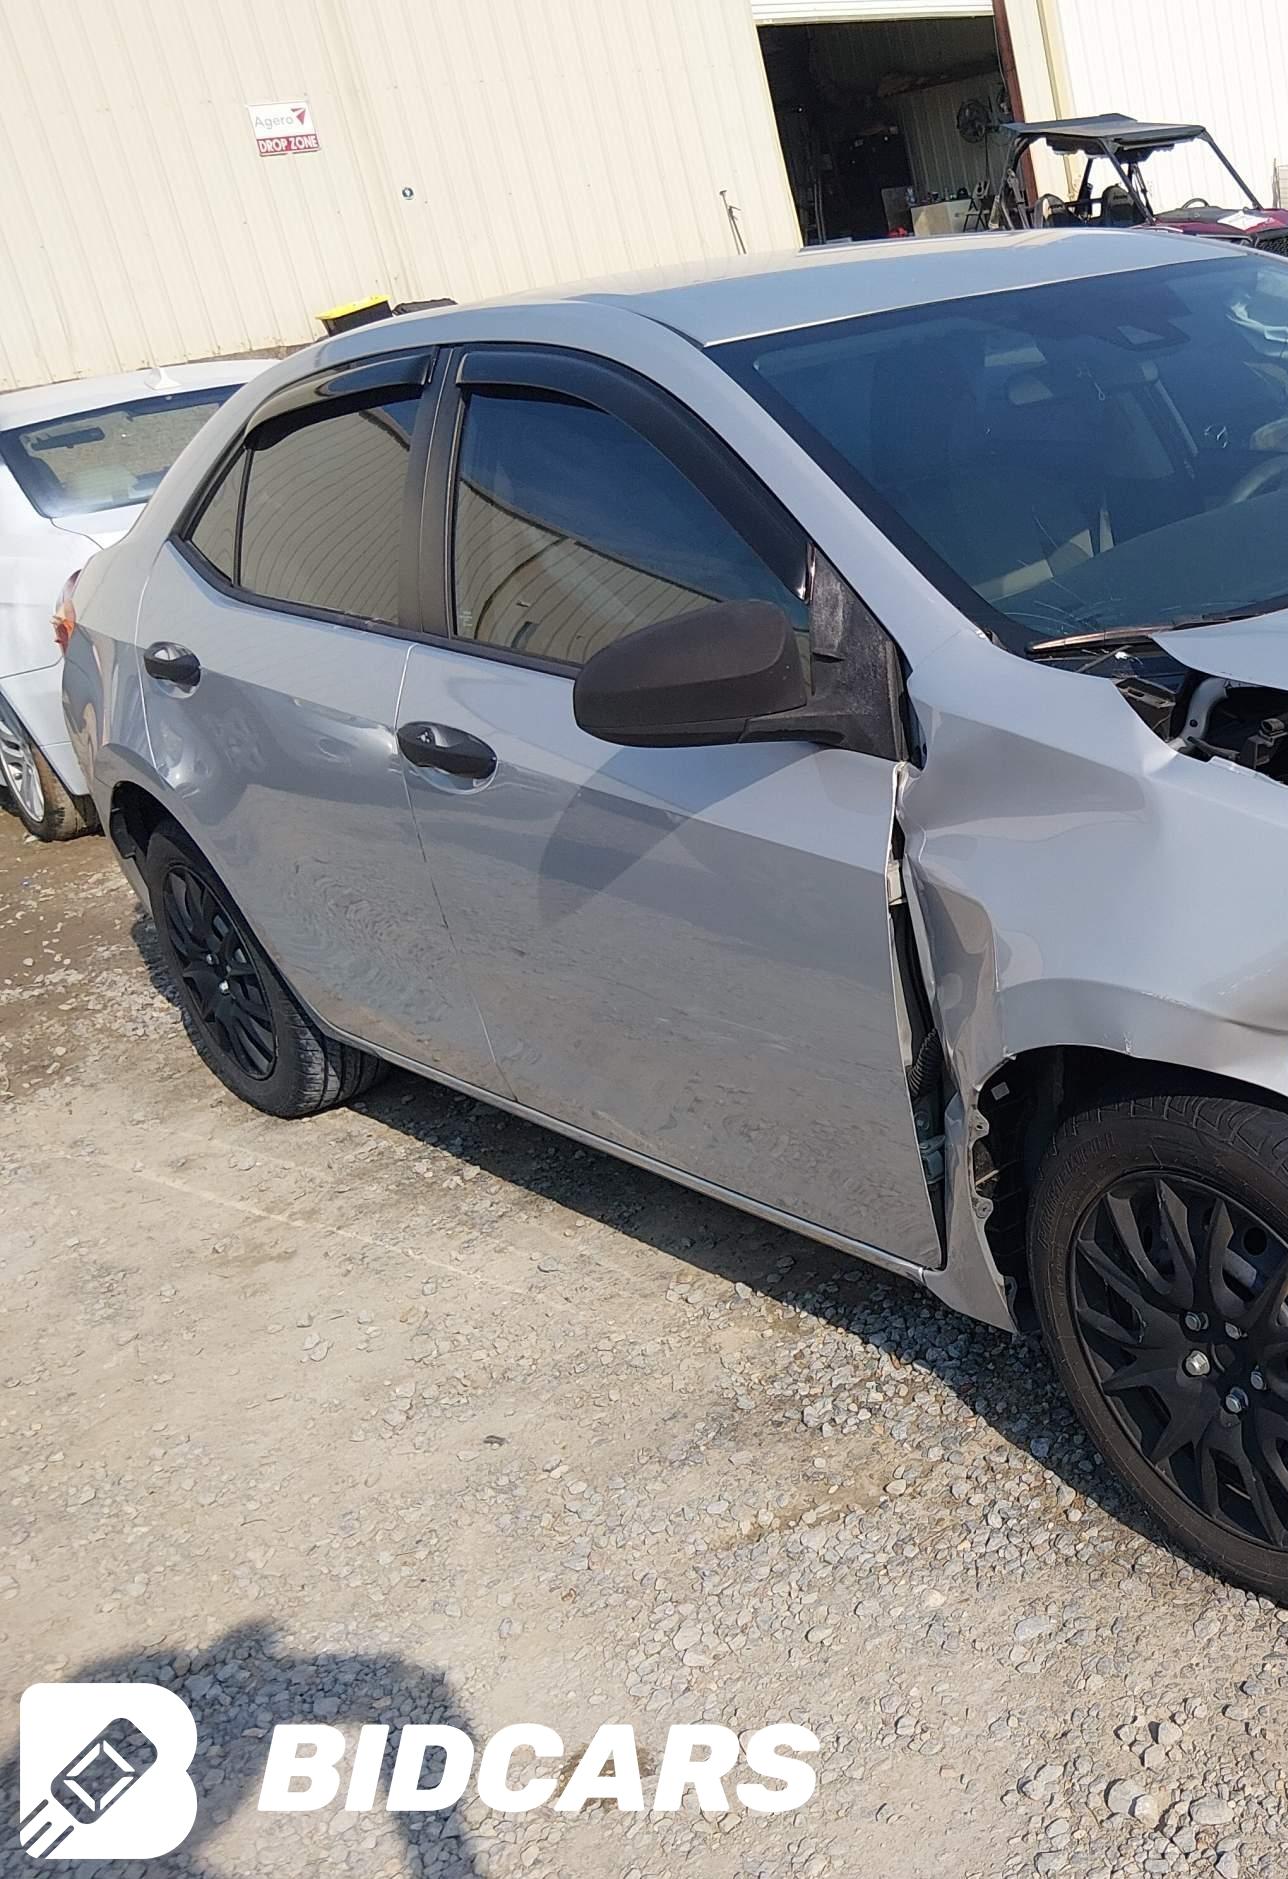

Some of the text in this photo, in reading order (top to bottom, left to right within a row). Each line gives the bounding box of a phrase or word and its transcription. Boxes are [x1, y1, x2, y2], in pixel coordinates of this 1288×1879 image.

[254, 115, 294, 130] Agero
[258, 135, 319, 153] DROP ZONE
